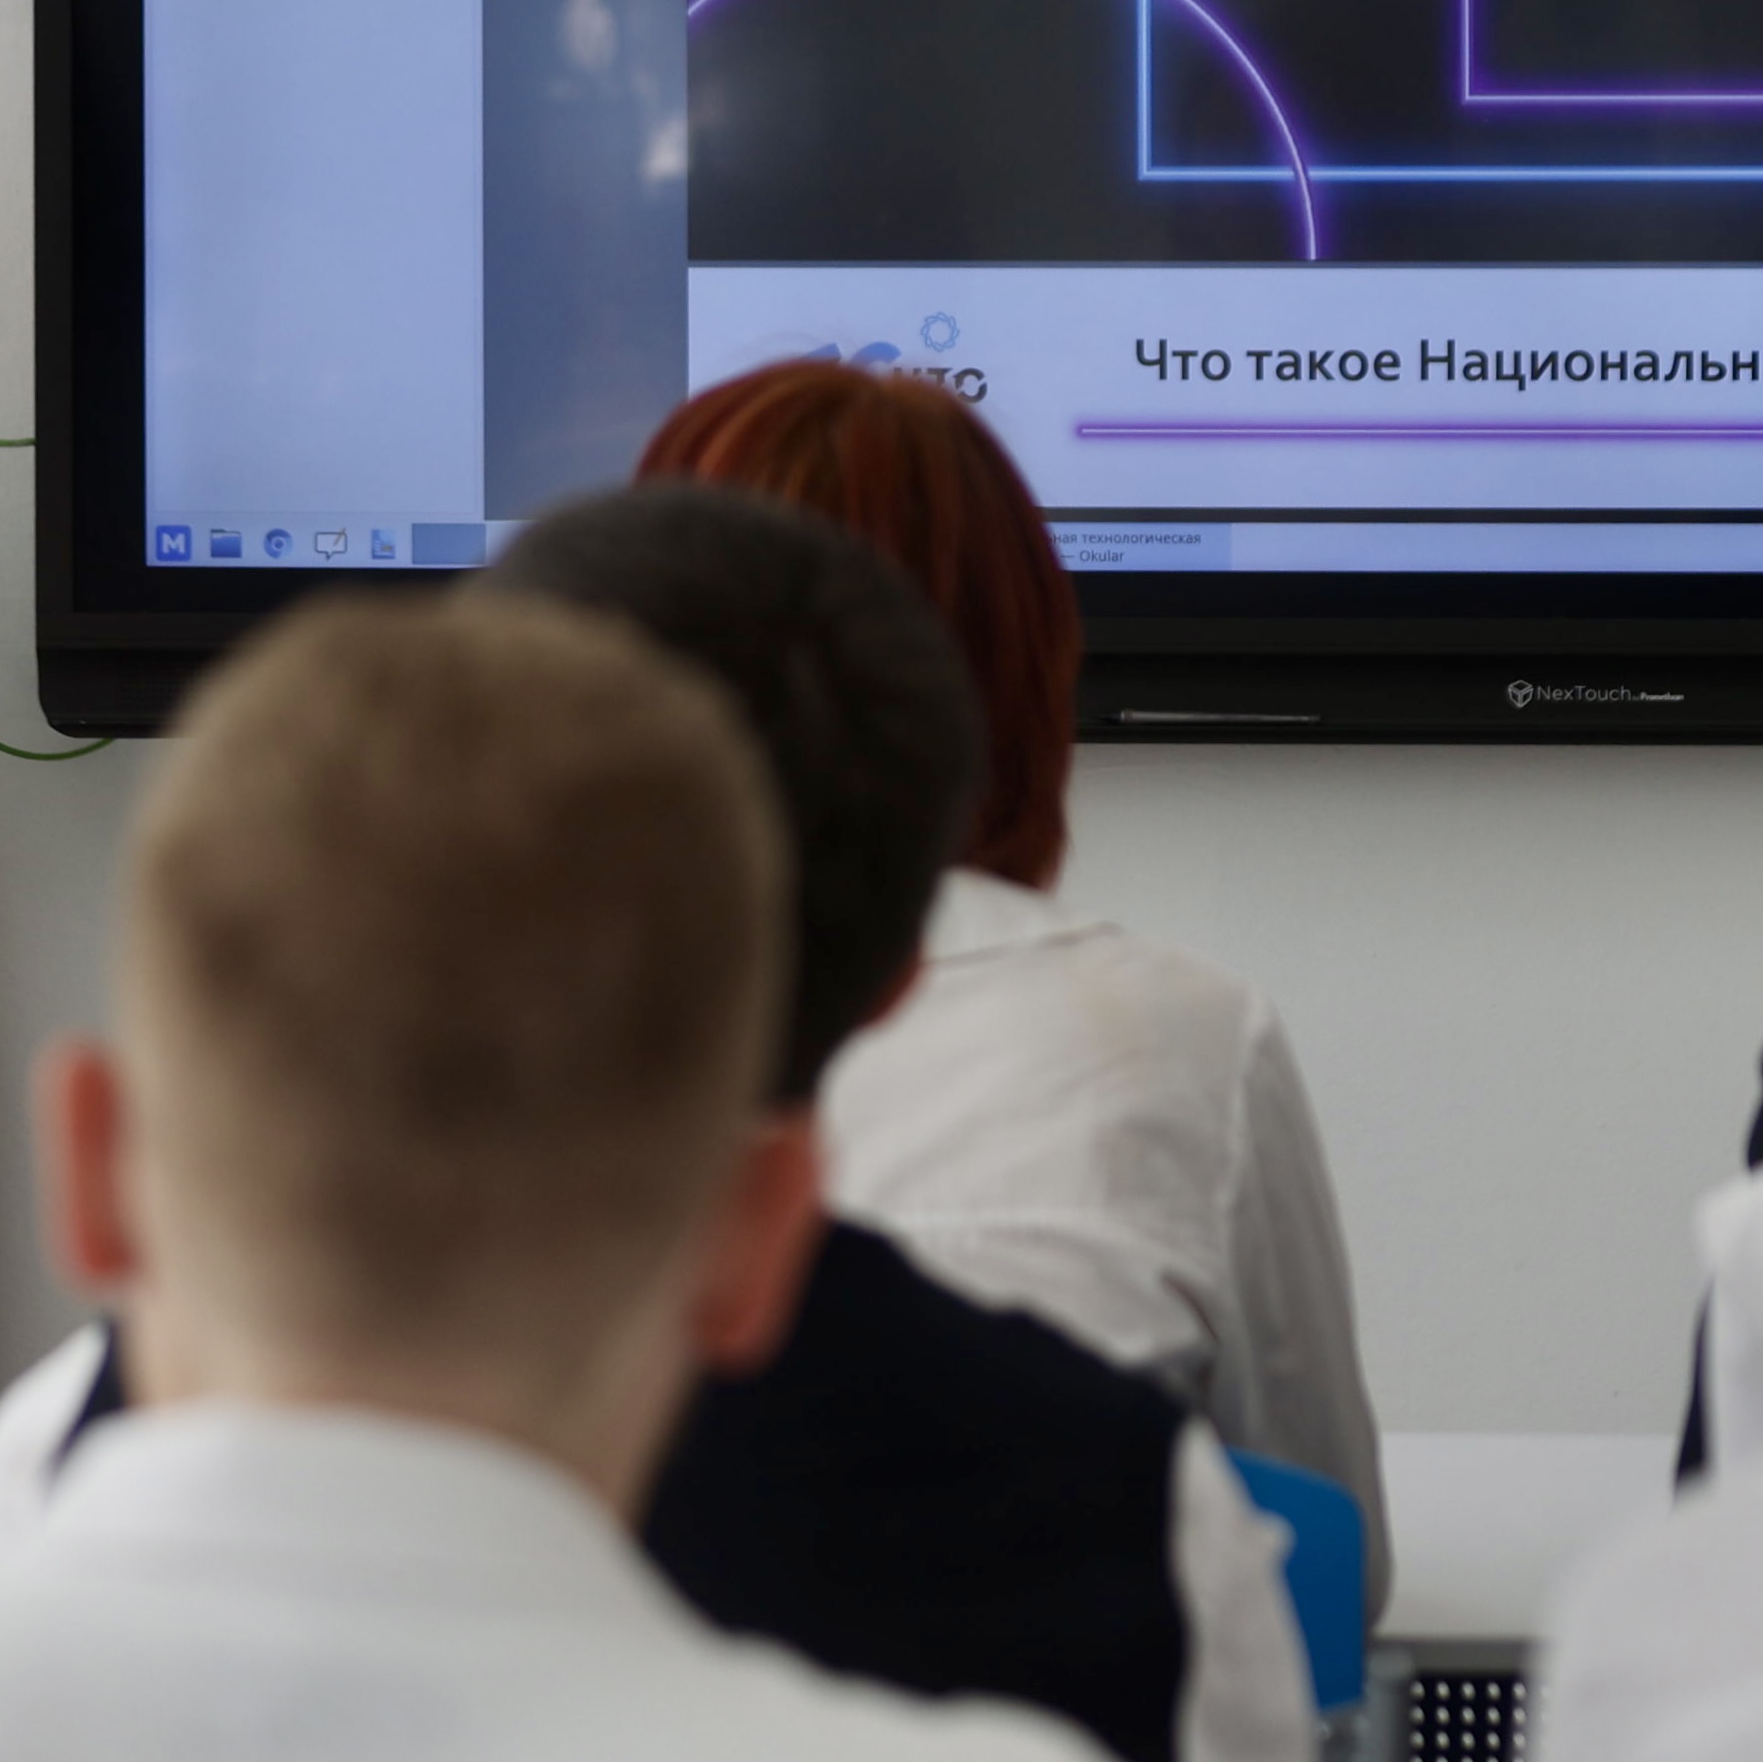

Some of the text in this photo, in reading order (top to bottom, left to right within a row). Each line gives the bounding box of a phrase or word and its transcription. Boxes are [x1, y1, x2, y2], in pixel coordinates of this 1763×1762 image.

[1134, 338, 1232, 383] Что
[1245, 348, 1402, 383] такое
[1083, 532, 1202, 546] технологическая
[1079, 549, 1124, 563] Okular
[1537, 685, 1632, 702] NexTouch
